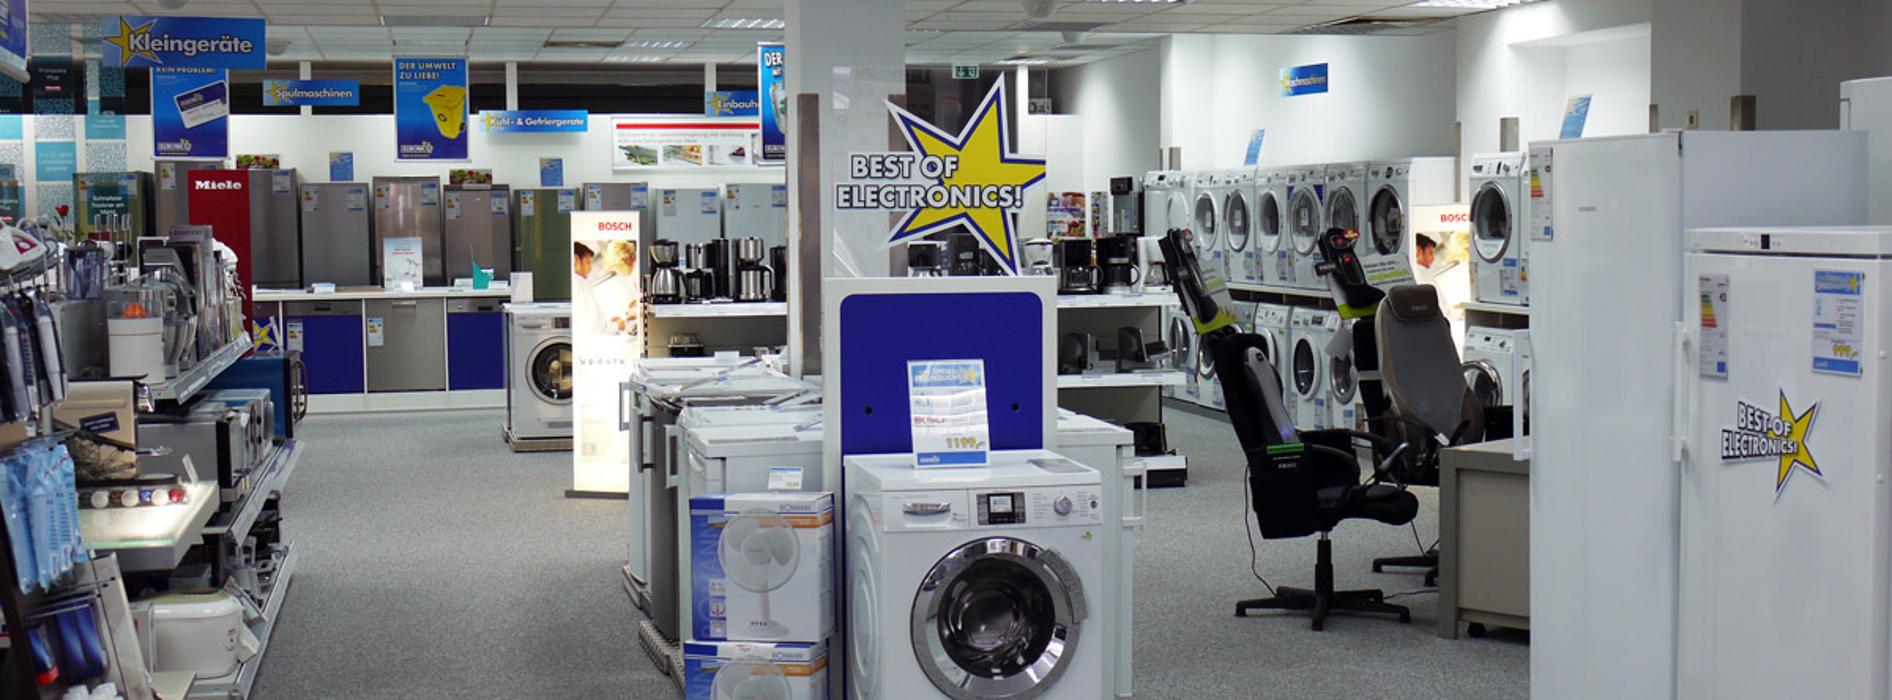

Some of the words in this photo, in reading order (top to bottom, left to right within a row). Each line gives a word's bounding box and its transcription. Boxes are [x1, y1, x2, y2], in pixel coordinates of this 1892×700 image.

[129, 33, 253, 57] Kleingeräte
[399, 62, 416, 70] DER
[418, 62, 457, 71] UMWELT
[399, 72, 413, 80] ZU
[851, 155, 914, 178] BEST
[920, 155, 959, 178] OF
[195, 180, 242, 190] Miele
[836, 184, 1023, 209] ELECTRONICS!
[598, 222, 632, 231] BOSCH
[1737, 401, 1770, 432] BEST
[1771, 415, 1792, 436] OF
[1721, 429, 1798, 460] ELECTRONICS!
